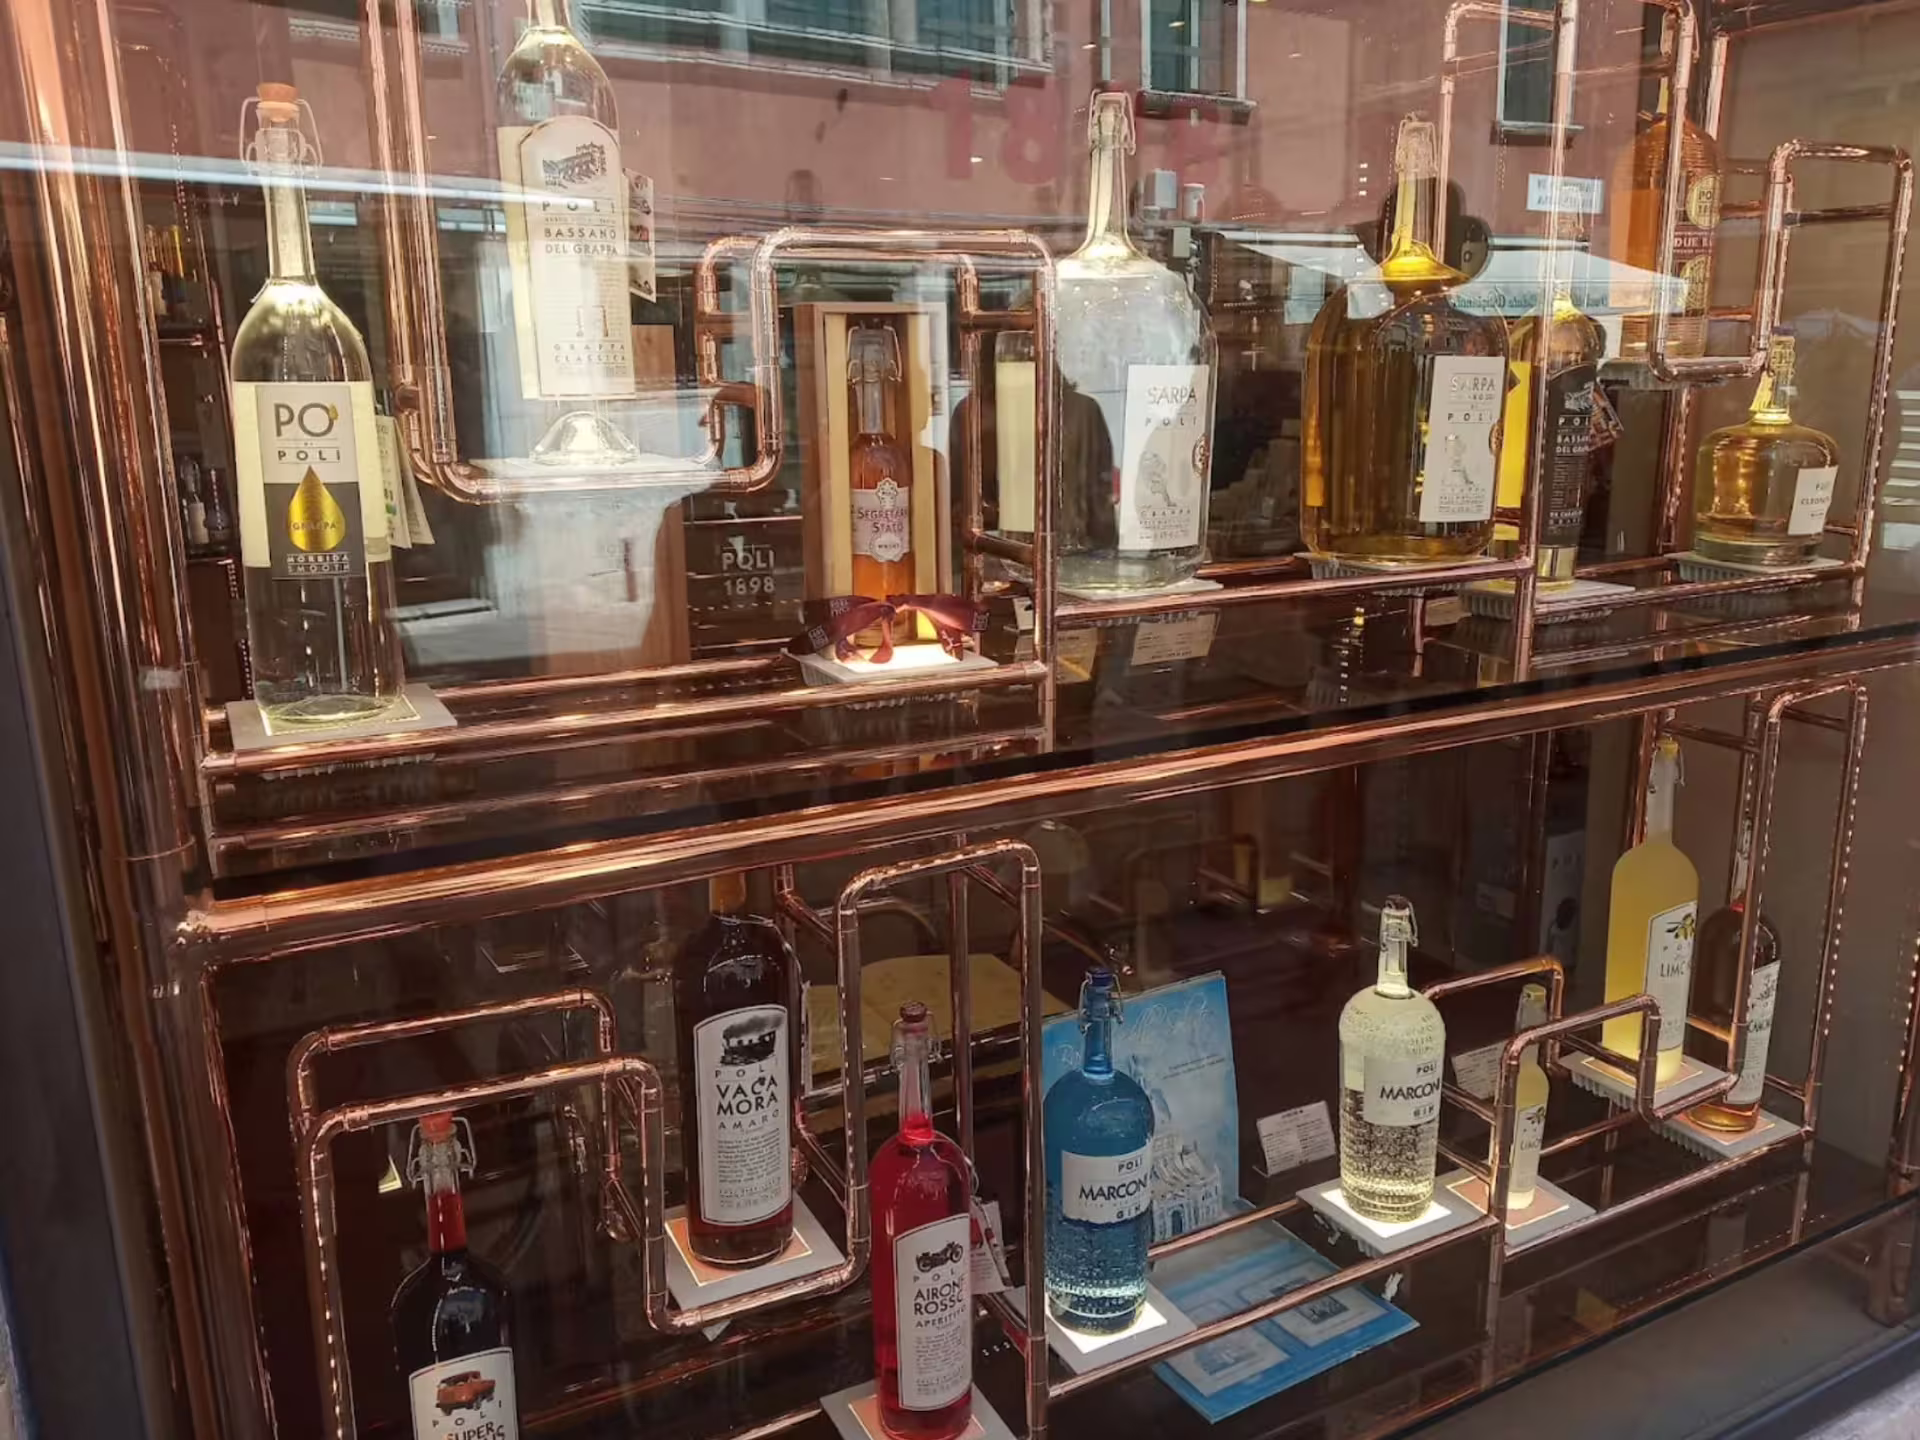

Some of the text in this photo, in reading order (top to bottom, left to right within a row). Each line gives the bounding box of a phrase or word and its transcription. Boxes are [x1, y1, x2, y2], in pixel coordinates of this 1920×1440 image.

[544, 228, 617, 240] BASSANO
[545, 243, 618, 256] DEL GRAPPA
[1147, 387, 1198, 404] SARPA
[1145, 416, 1198, 427] POLI
[278, 449, 341, 461] POLI
[286, 554, 350, 563] MORBIDA
[722, 550, 775, 571] POLI
[288, 564, 350, 573] SMOOTH
[724, 577, 776, 595] 1898
[1415, 1063, 1437, 1074] POLI
[716, 1075, 779, 1100] VACA
[716, 1091, 779, 1116] MORA
[718, 1109, 780, 1130] AMARO
[1118, 1157, 1143, 1173] POLI
[1116, 1204, 1142, 1219] GIN
[432, 1399, 502, 1428] POLI
